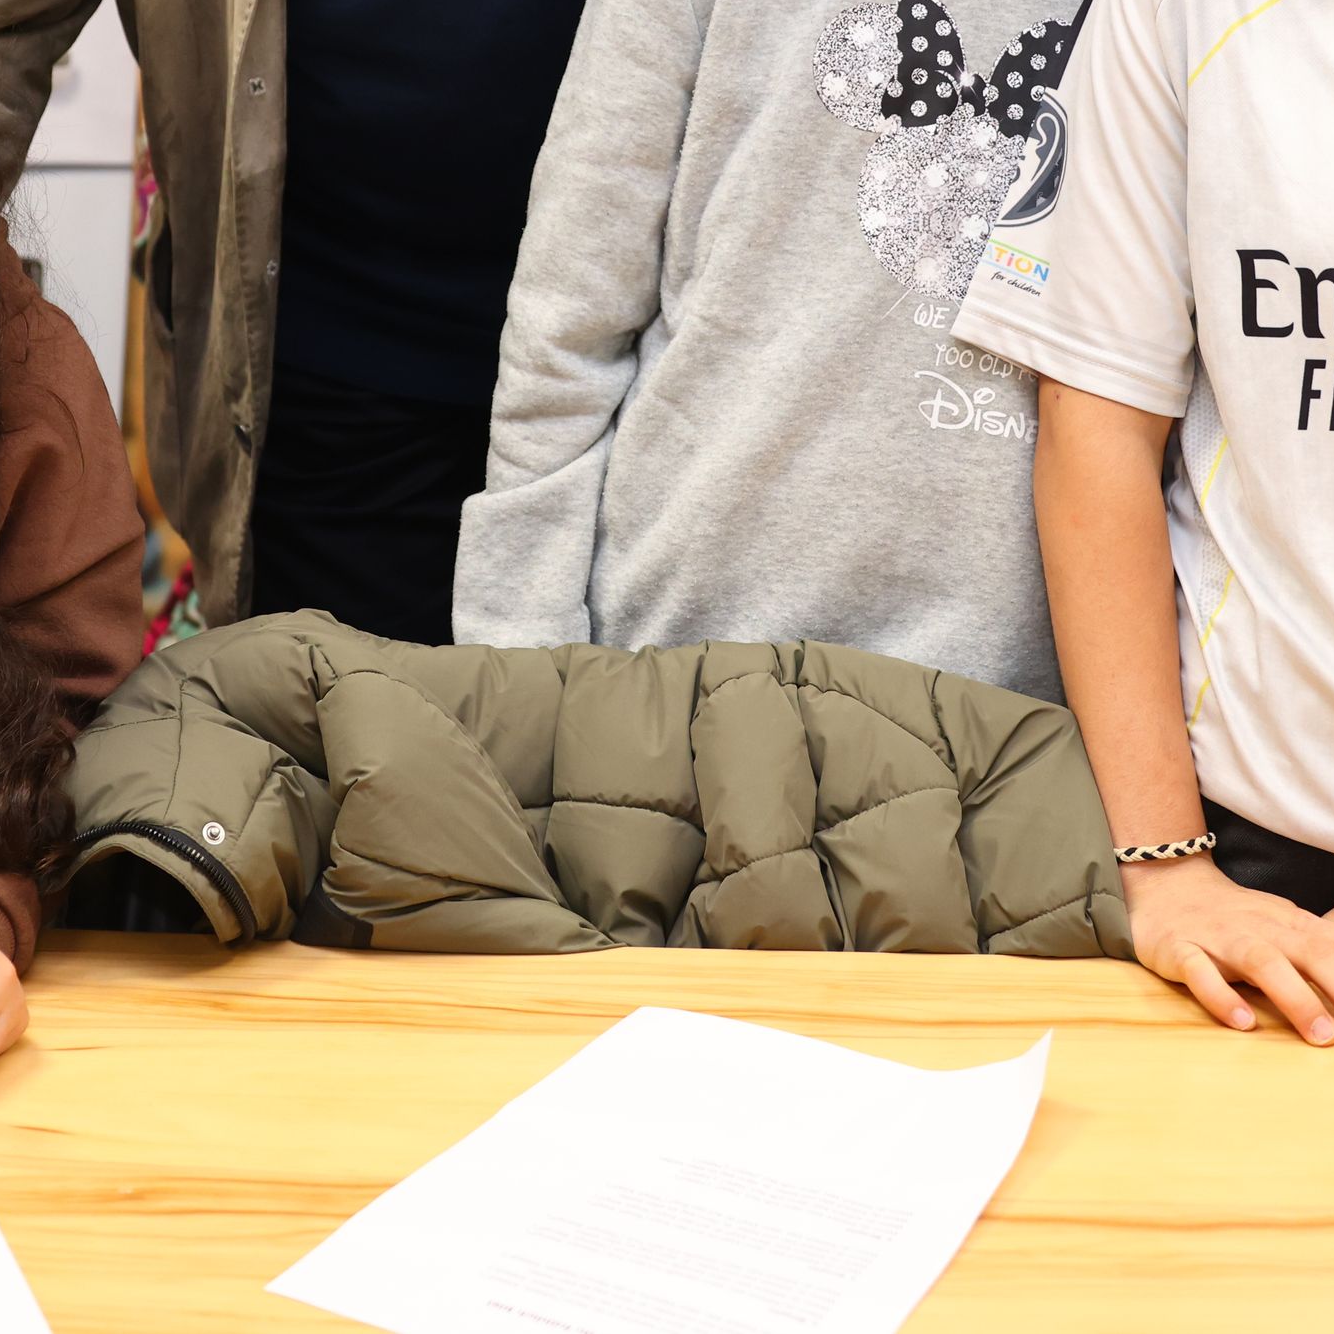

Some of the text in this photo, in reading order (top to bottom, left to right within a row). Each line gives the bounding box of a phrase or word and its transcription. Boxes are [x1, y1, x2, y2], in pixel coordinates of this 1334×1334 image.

[991, 271, 1041, 297] for children
[913, 303, 950, 329] WE
[979, 354, 1013, 378] OLD
